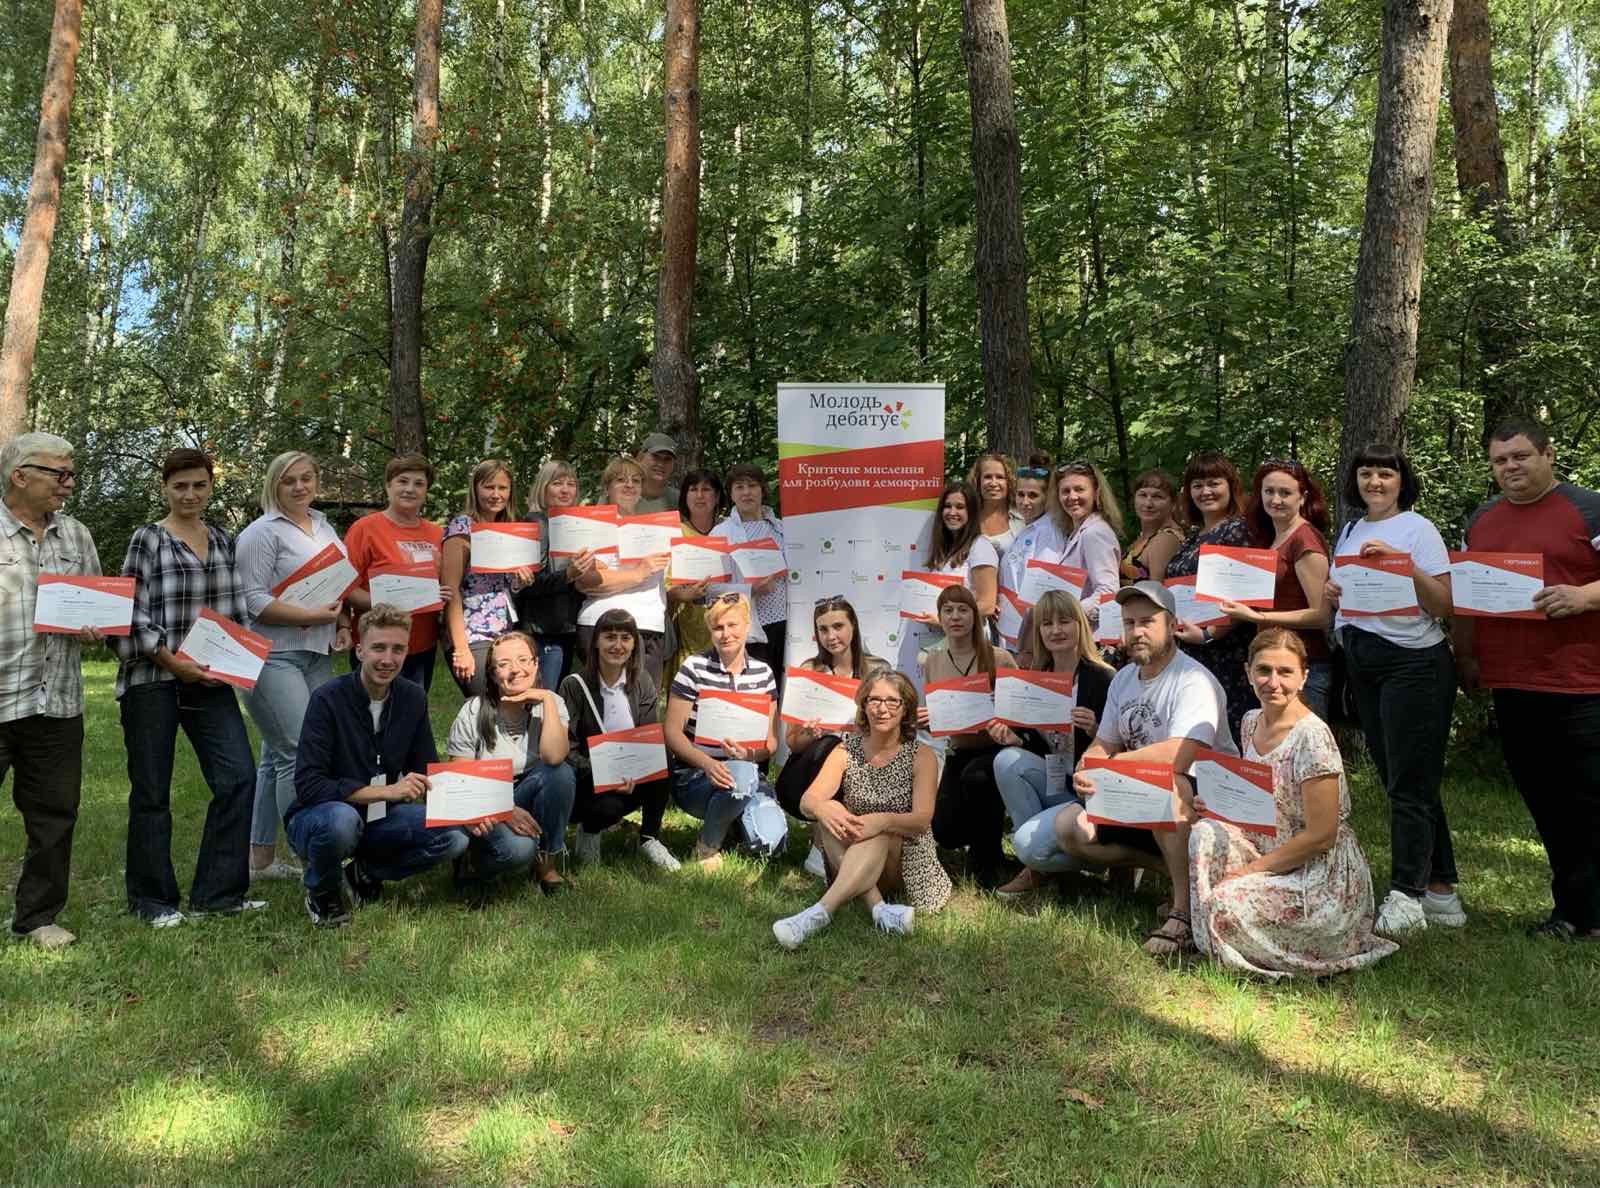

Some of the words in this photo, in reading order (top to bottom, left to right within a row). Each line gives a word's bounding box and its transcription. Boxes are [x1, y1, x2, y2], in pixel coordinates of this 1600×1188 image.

[809, 393, 882, 411] Молодь
[826, 412, 899, 430] дебатує
[798, 463, 861, 477] Критичне
[864, 466, 924, 474] мислення
[783, 479, 801, 488] для
[806, 476, 870, 489] розбудови
[873, 476, 939, 489] демократії
